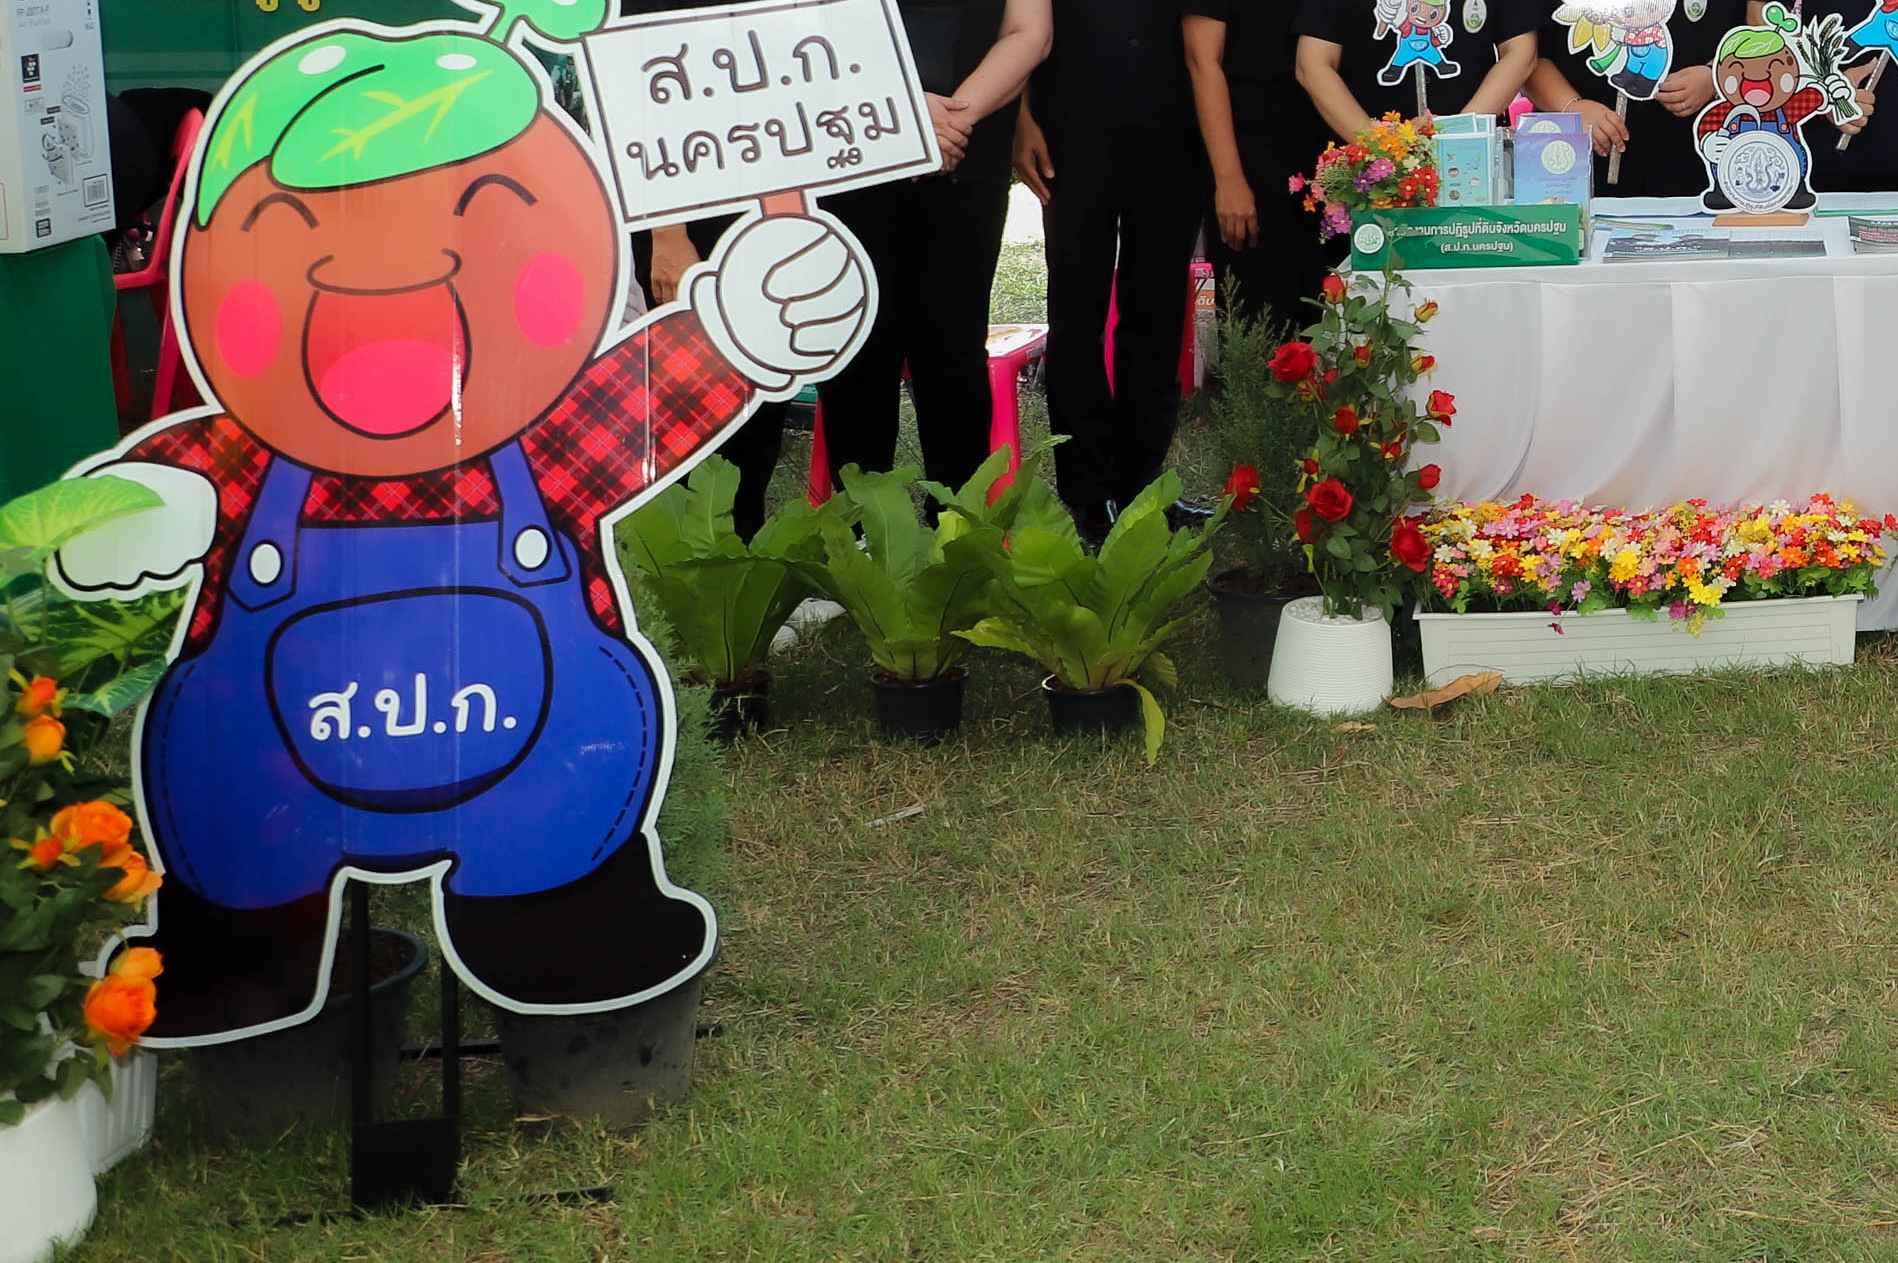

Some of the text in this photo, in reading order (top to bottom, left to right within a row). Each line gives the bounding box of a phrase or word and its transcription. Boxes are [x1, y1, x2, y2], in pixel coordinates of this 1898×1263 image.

[641, 30, 861, 104] ส.ป.ก.
[626, 97, 901, 179] นครปฐม
[308, 672, 517, 740] ส.ป.ก.
